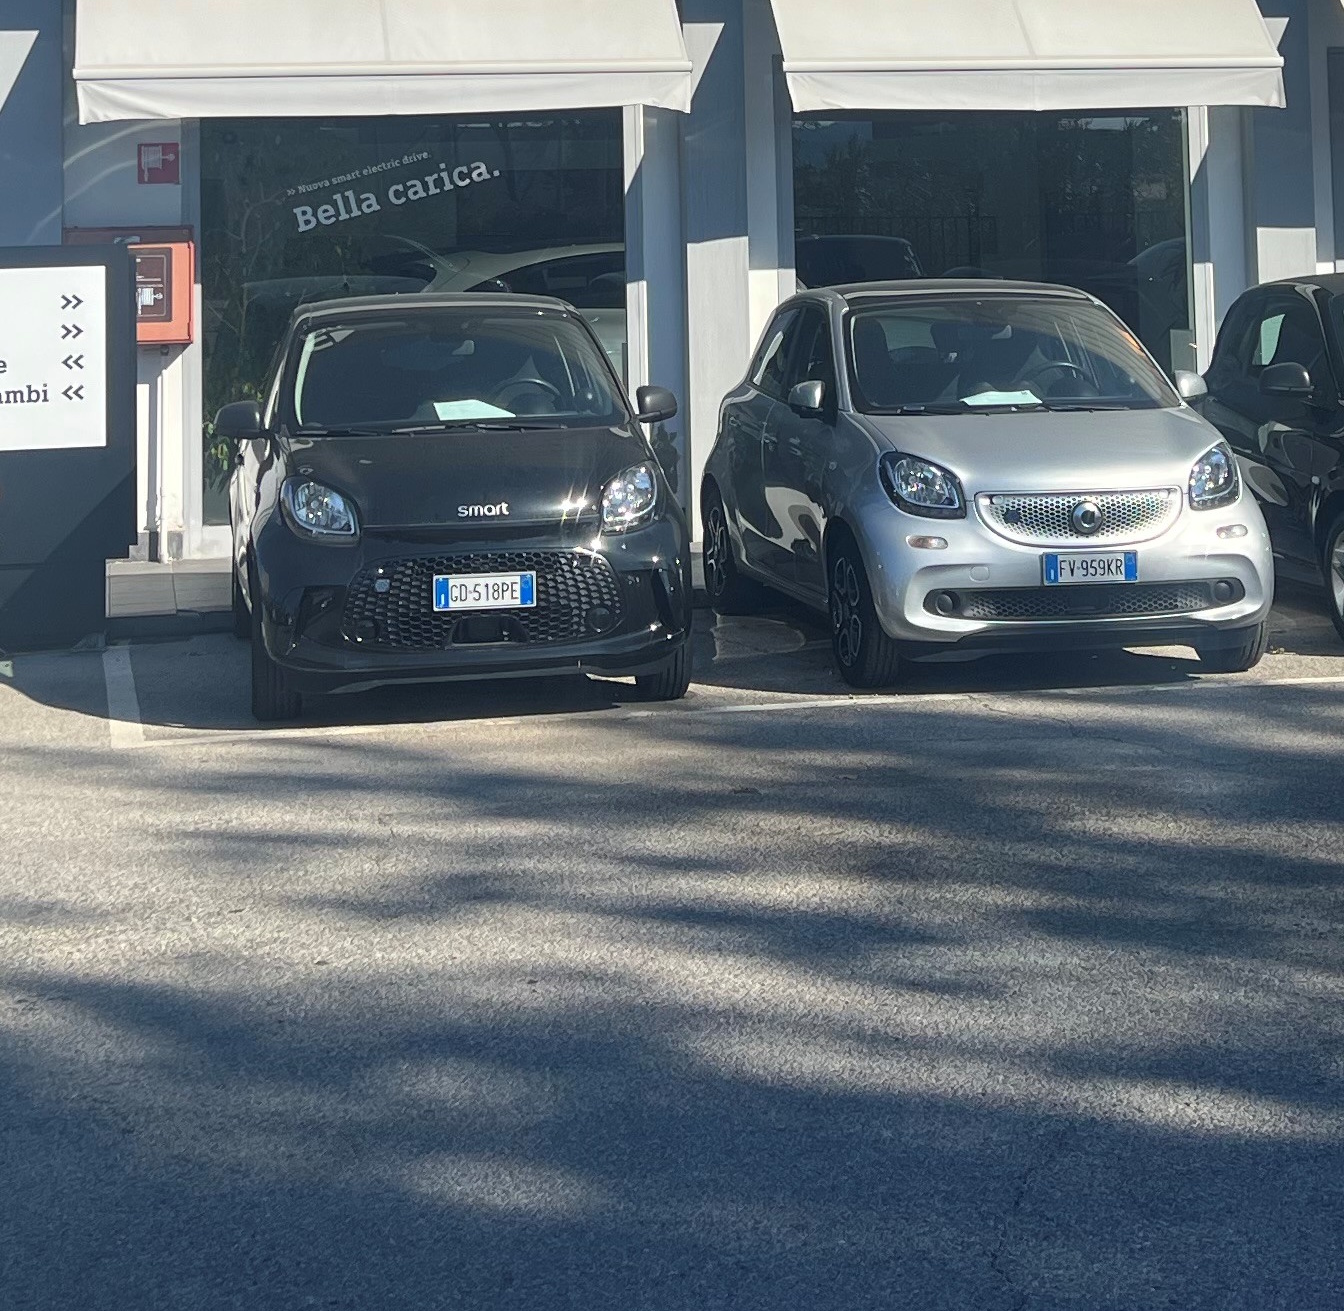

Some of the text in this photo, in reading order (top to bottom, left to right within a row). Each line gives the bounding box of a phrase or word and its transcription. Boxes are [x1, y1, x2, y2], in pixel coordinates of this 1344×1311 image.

[298, 179, 330, 194] Nuova
[331, 170, 361, 185] smart
[362, 158, 400, 176] electric
[293, 161, 501, 233] Bella carica.
[457, 501, 510, 517] smart
